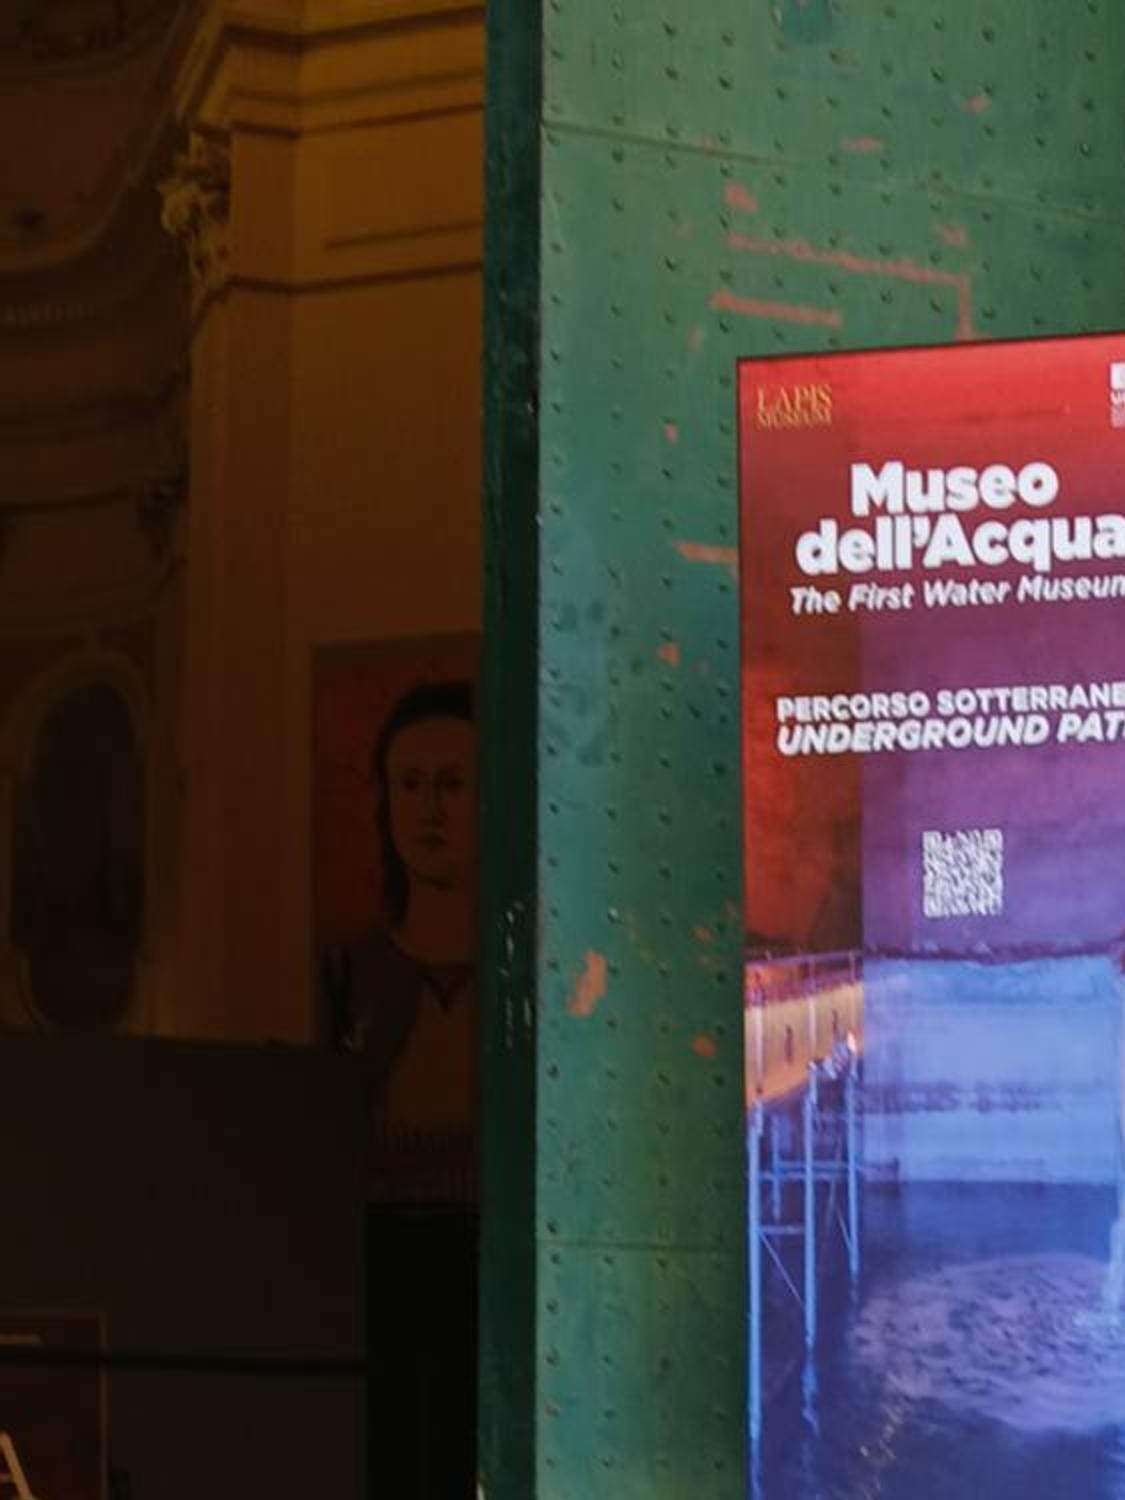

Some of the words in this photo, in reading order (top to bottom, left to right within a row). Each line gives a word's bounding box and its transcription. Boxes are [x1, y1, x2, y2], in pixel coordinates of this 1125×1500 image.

[851, 461, 1058, 516] Museo
[791, 588, 840, 615] The
[848, 581, 914, 612] First
[924, 578, 1010, 608] Water
[776, 691, 930, 723] PERCORSO
[777, 716, 1049, 756] UNDERGROUND
